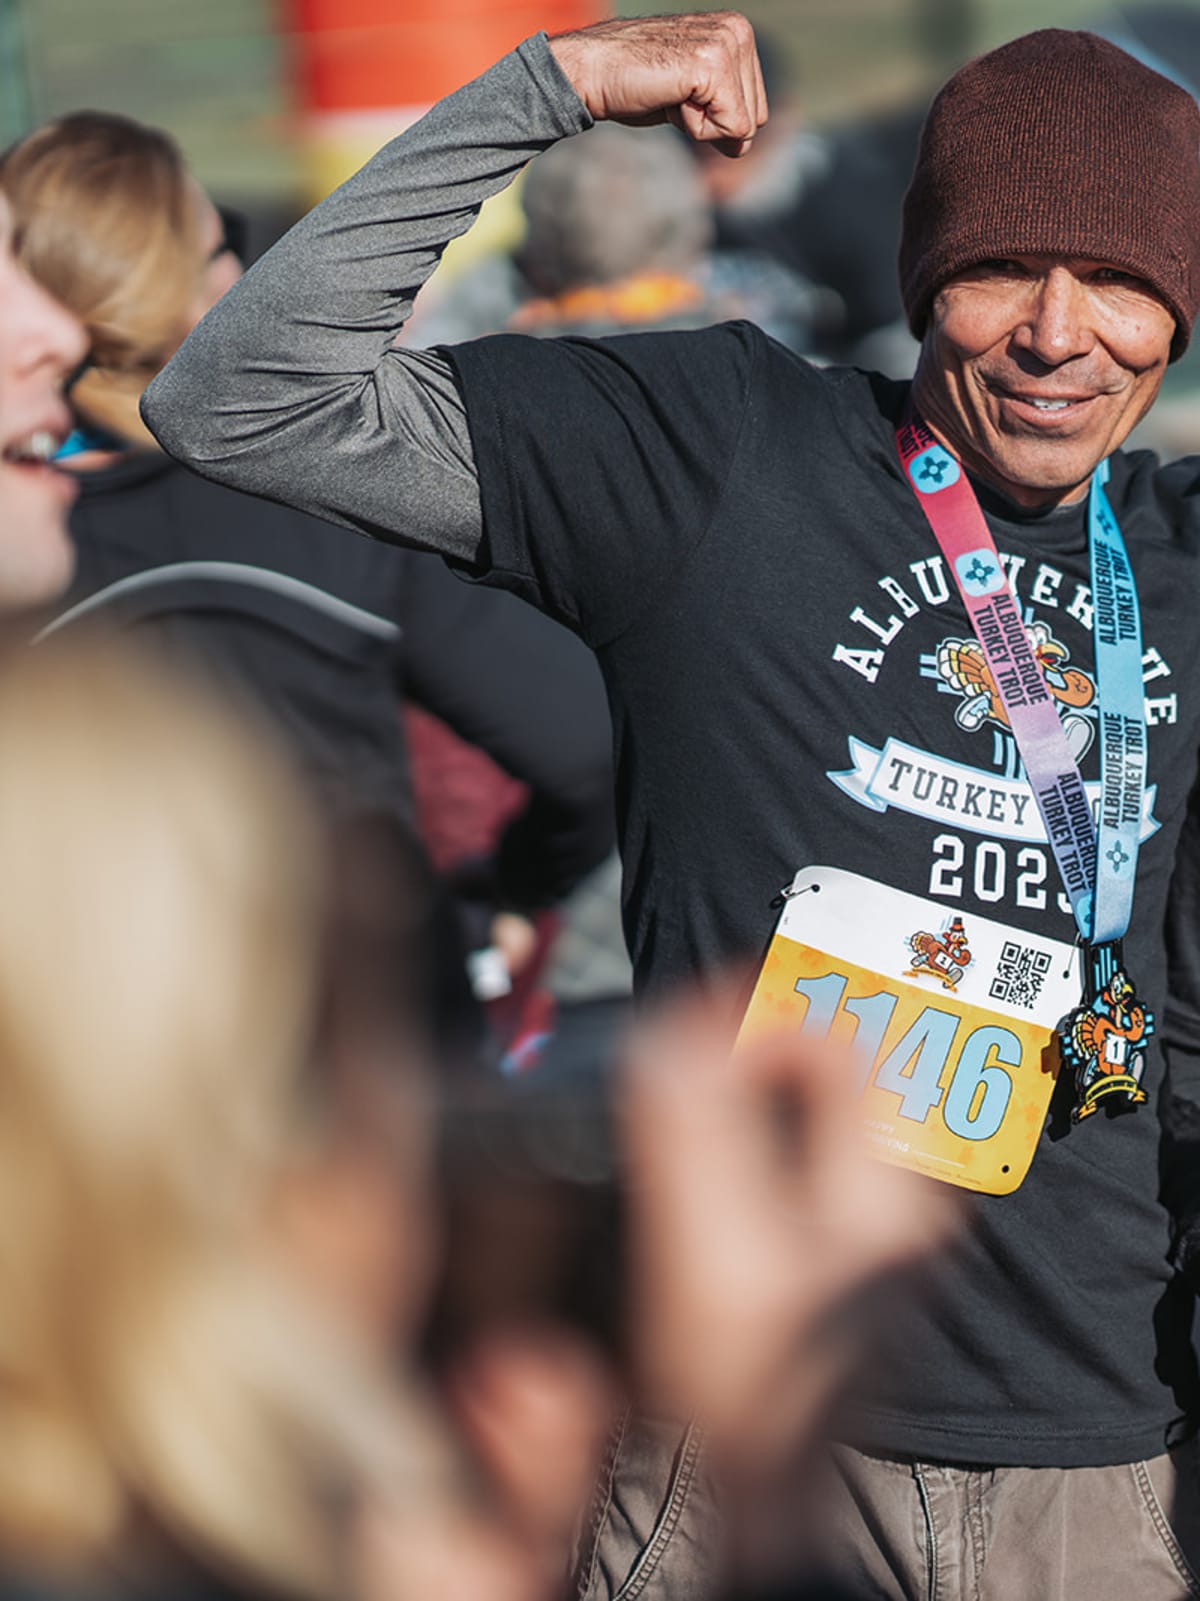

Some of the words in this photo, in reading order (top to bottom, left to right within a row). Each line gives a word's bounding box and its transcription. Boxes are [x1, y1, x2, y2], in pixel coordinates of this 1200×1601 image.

[1094, 539, 1117, 646] ALBUQUERQUE
[1111, 547, 1132, 585] TROT
[1115, 586, 1137, 641] TURKEY
[973, 605, 1011, 669] TURKEY
[997, 667, 1028, 708] TROT
[991, 593, 1050, 704] ALBUQUERQUE
[1103, 711, 1123, 829] ALBUQUERQUE
[1124, 717, 1143, 753] TROT
[889, 757, 1031, 826] TURKEY
[1038, 785, 1074, 850] TURKEY
[1059, 849, 1086, 893] TROT
[1121, 753, 1141, 824] TURKEY
[795, 972, 1024, 1142] 1146
